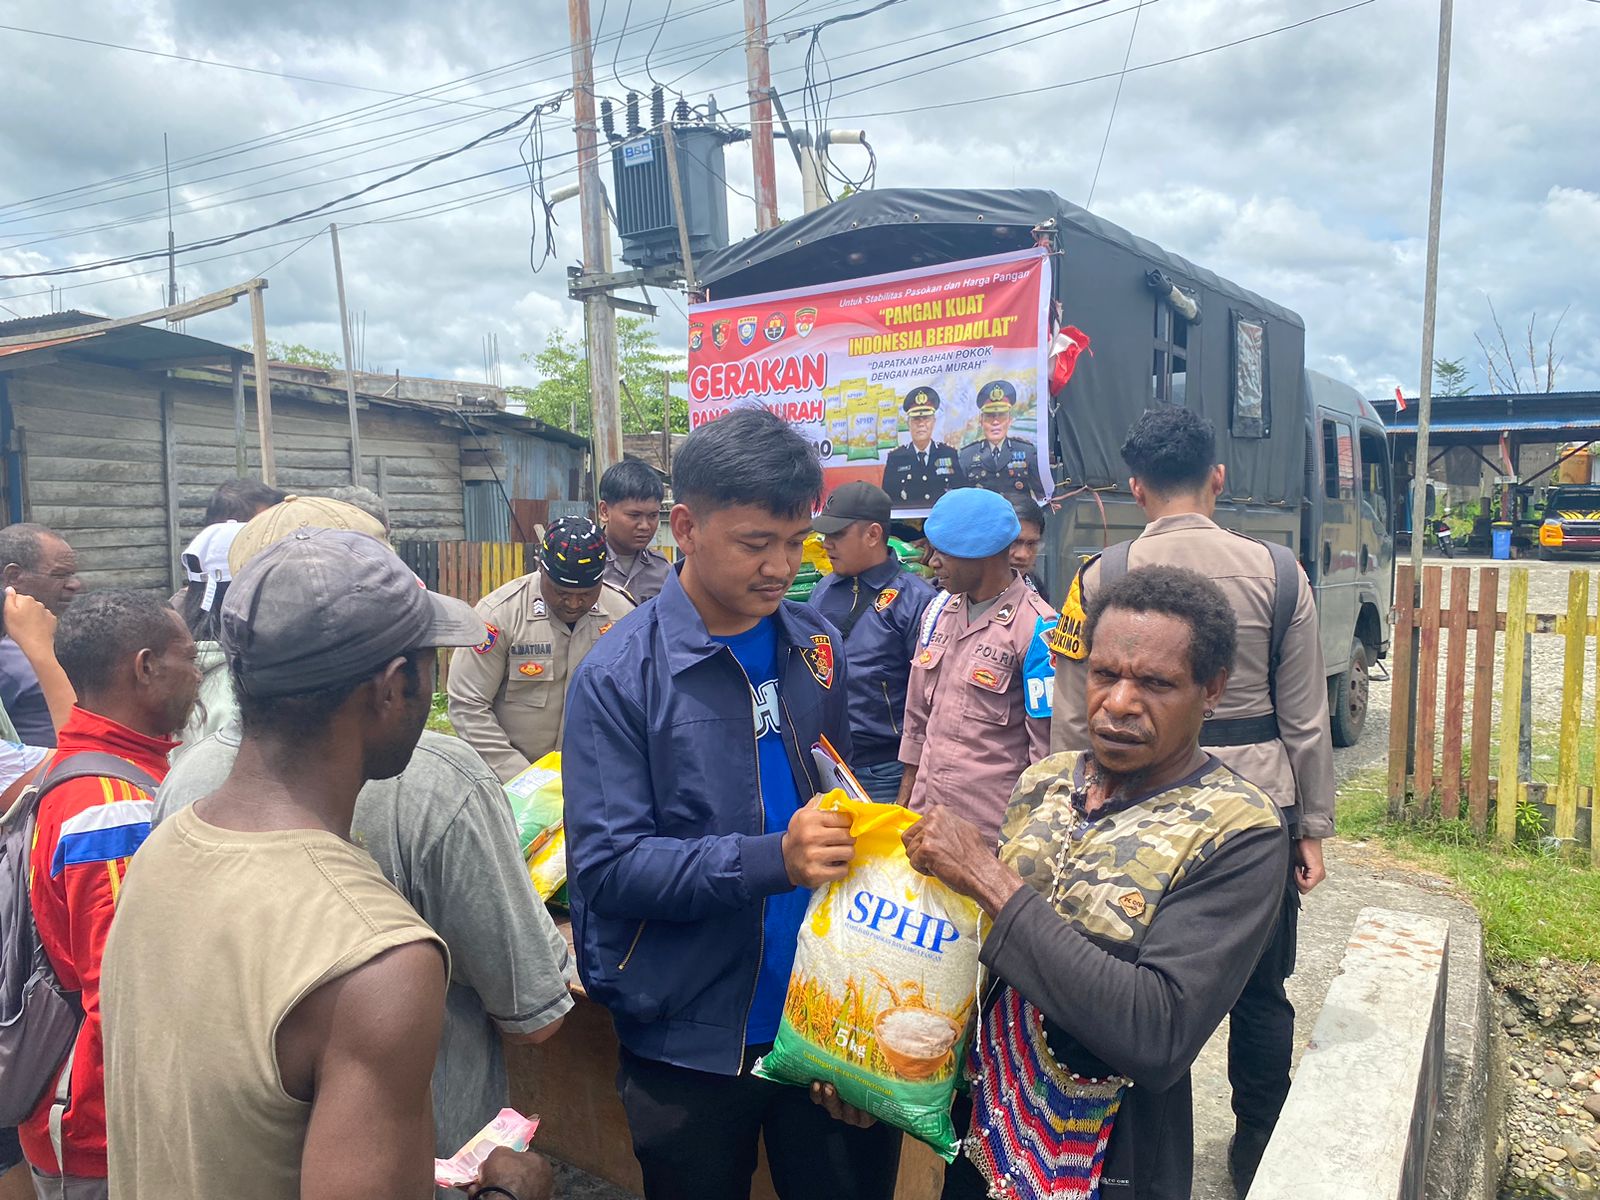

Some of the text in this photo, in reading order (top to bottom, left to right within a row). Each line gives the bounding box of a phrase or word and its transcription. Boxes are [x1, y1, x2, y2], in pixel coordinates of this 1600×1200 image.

[839, 270, 1031, 308] Untuk Stabilitas Pasokan dan Harga Pangan
[945, 294, 985, 318] KUAT
[848, 329, 923, 357] INDONESIA
[921, 351, 954, 364] BAHAN
[955, 346, 992, 359] POKOK
[689, 353, 827, 400] GERAKAN
[871, 369, 910, 382] DENGAN
[911, 365, 943, 377] HARGA
[975, 644, 1014, 667] POLRI
[847, 891, 960, 953] SPHP
[836, 1027, 866, 1058] 5 kg
